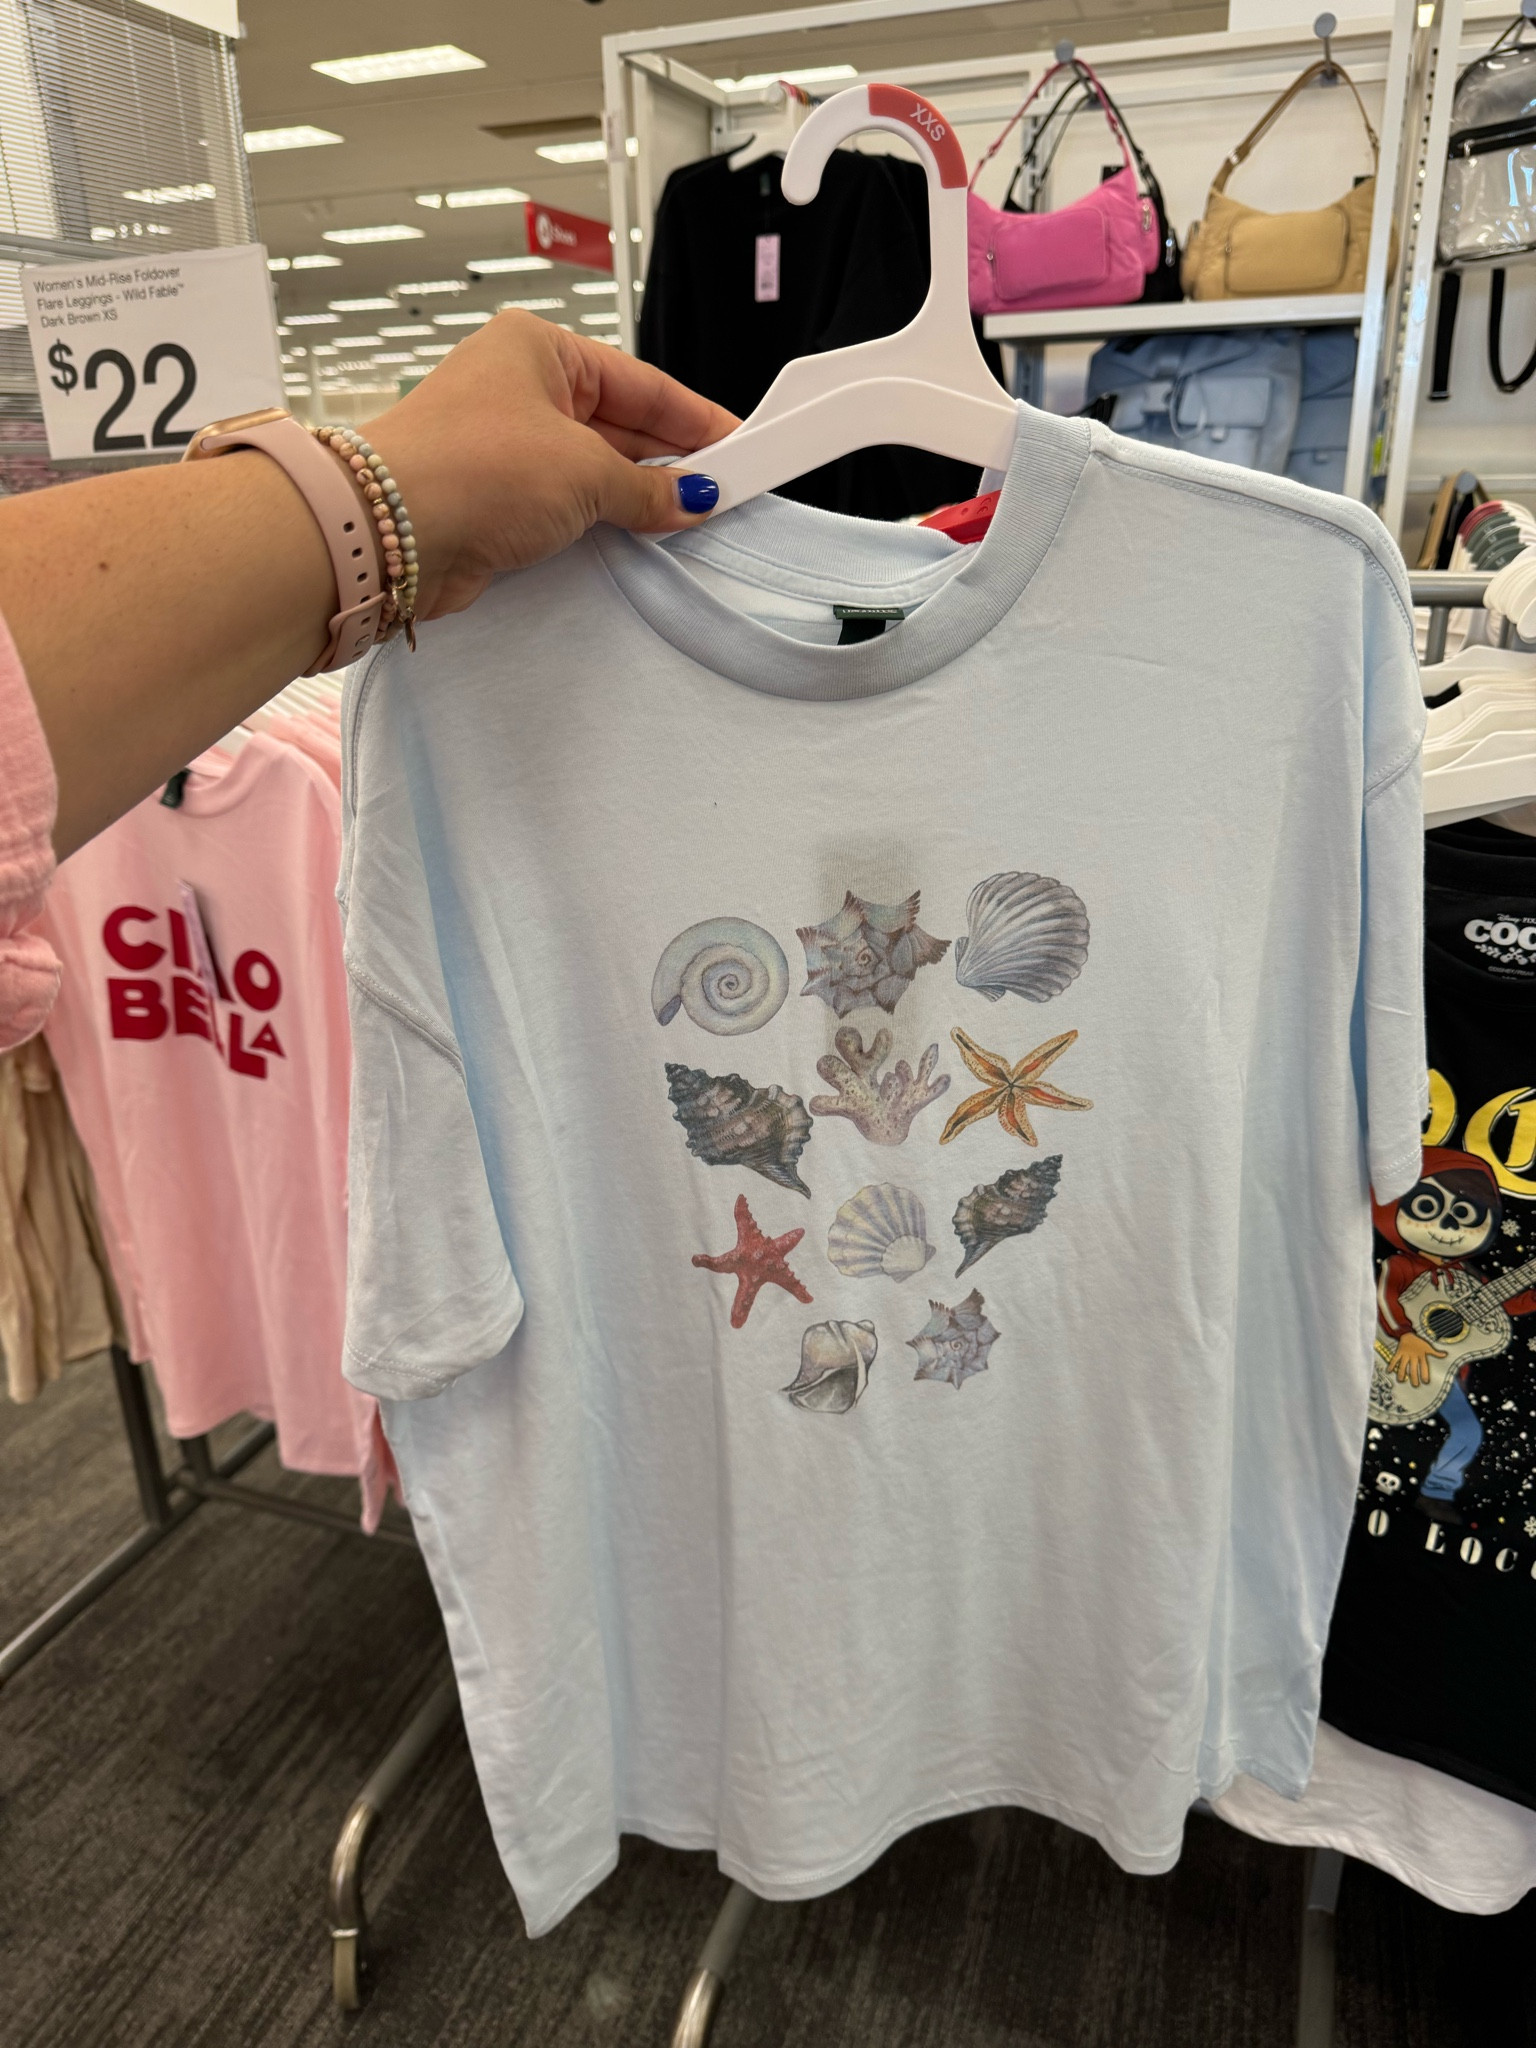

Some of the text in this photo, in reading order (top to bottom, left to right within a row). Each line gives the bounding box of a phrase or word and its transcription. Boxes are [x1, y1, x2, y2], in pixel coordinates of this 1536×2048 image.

[910, 102, 946, 142] XXS
[33, 268, 180, 293] Women's Mid-Rise Foldover
[37, 298, 63, 311] Flare
[66, 292, 113, 309] Leggings
[122, 288, 146, 301] Wild
[41, 308, 118, 328] Dark Brown XS
